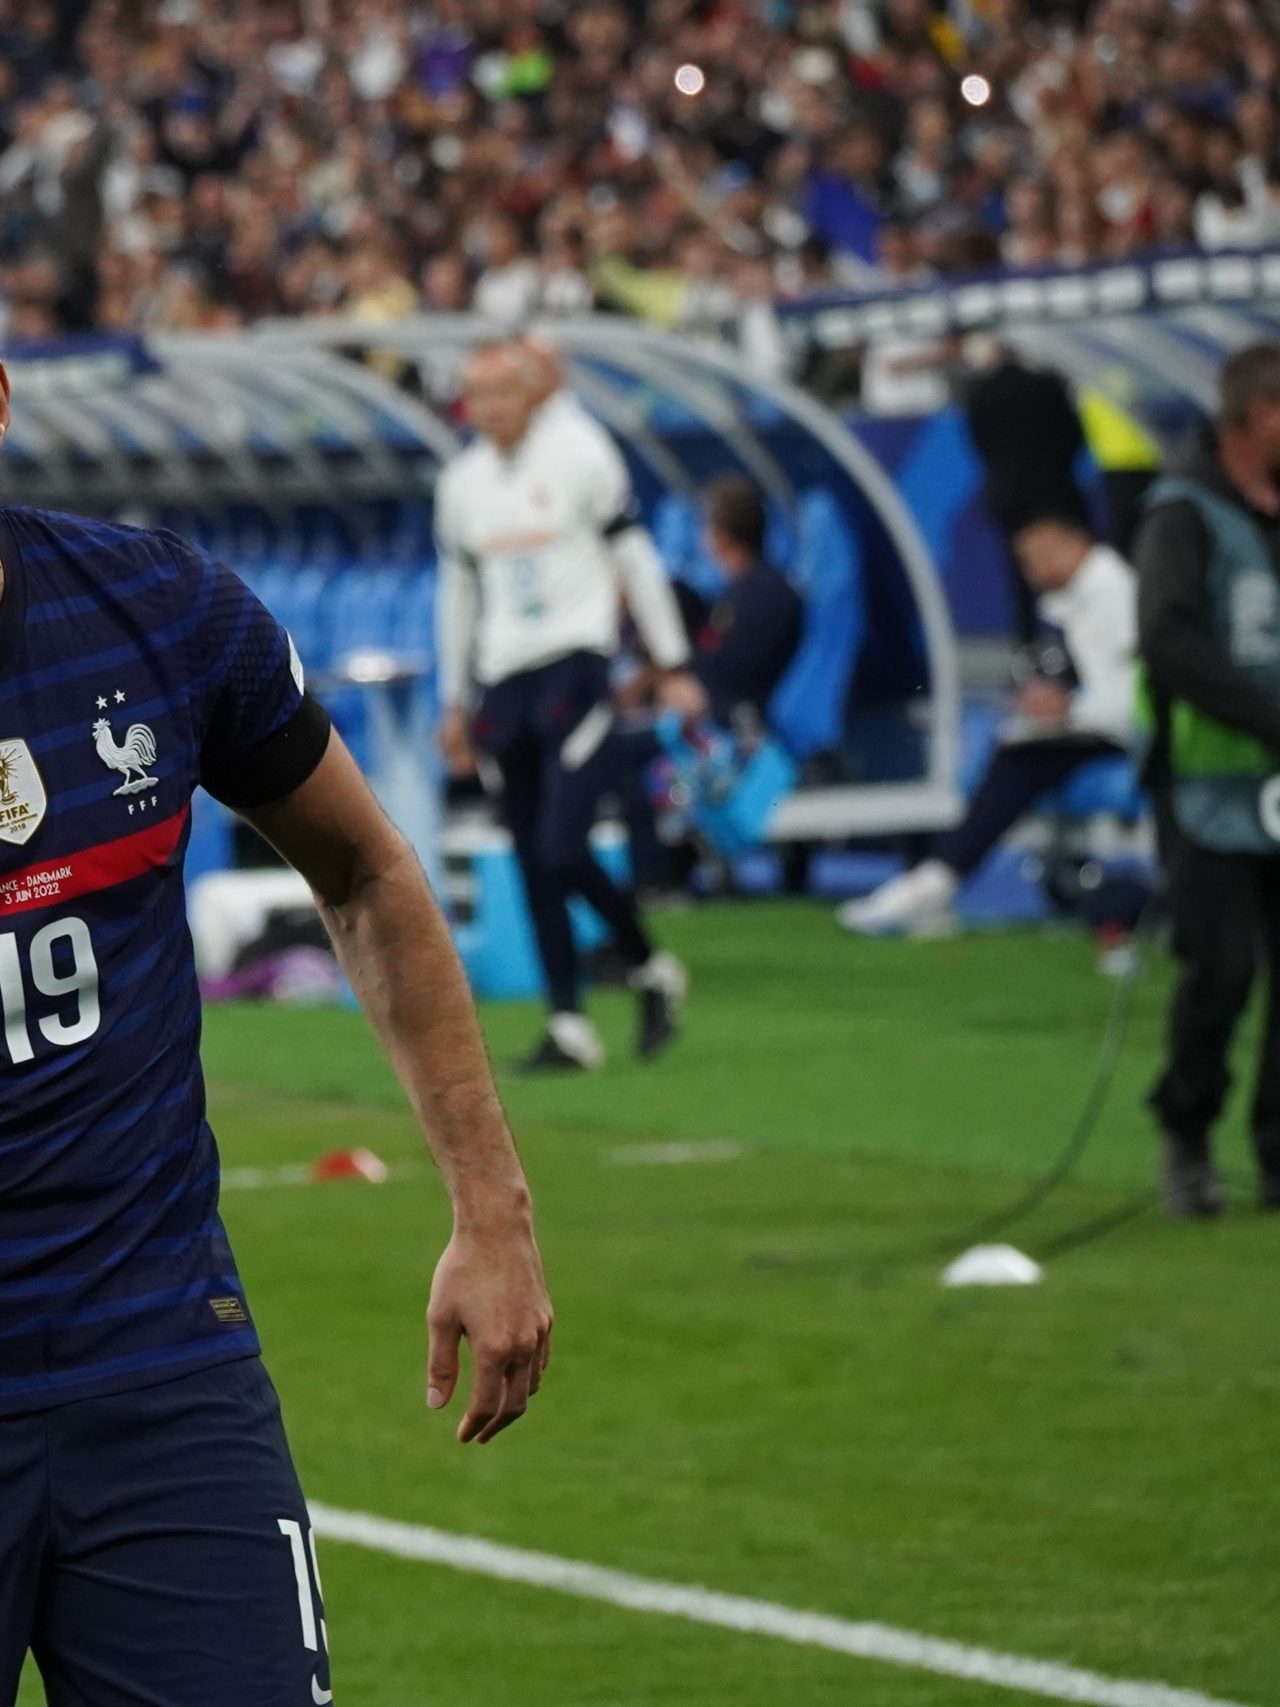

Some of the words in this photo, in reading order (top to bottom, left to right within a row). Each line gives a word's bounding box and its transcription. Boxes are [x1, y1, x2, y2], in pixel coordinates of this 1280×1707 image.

[26, 865, 72, 887] DANEMARK
[4, 893, 12, 905] 3
[15, 889, 32, 903] JUIN
[33, 882, 61, 899] 2022
[277, 1519, 328, 1656] 1
